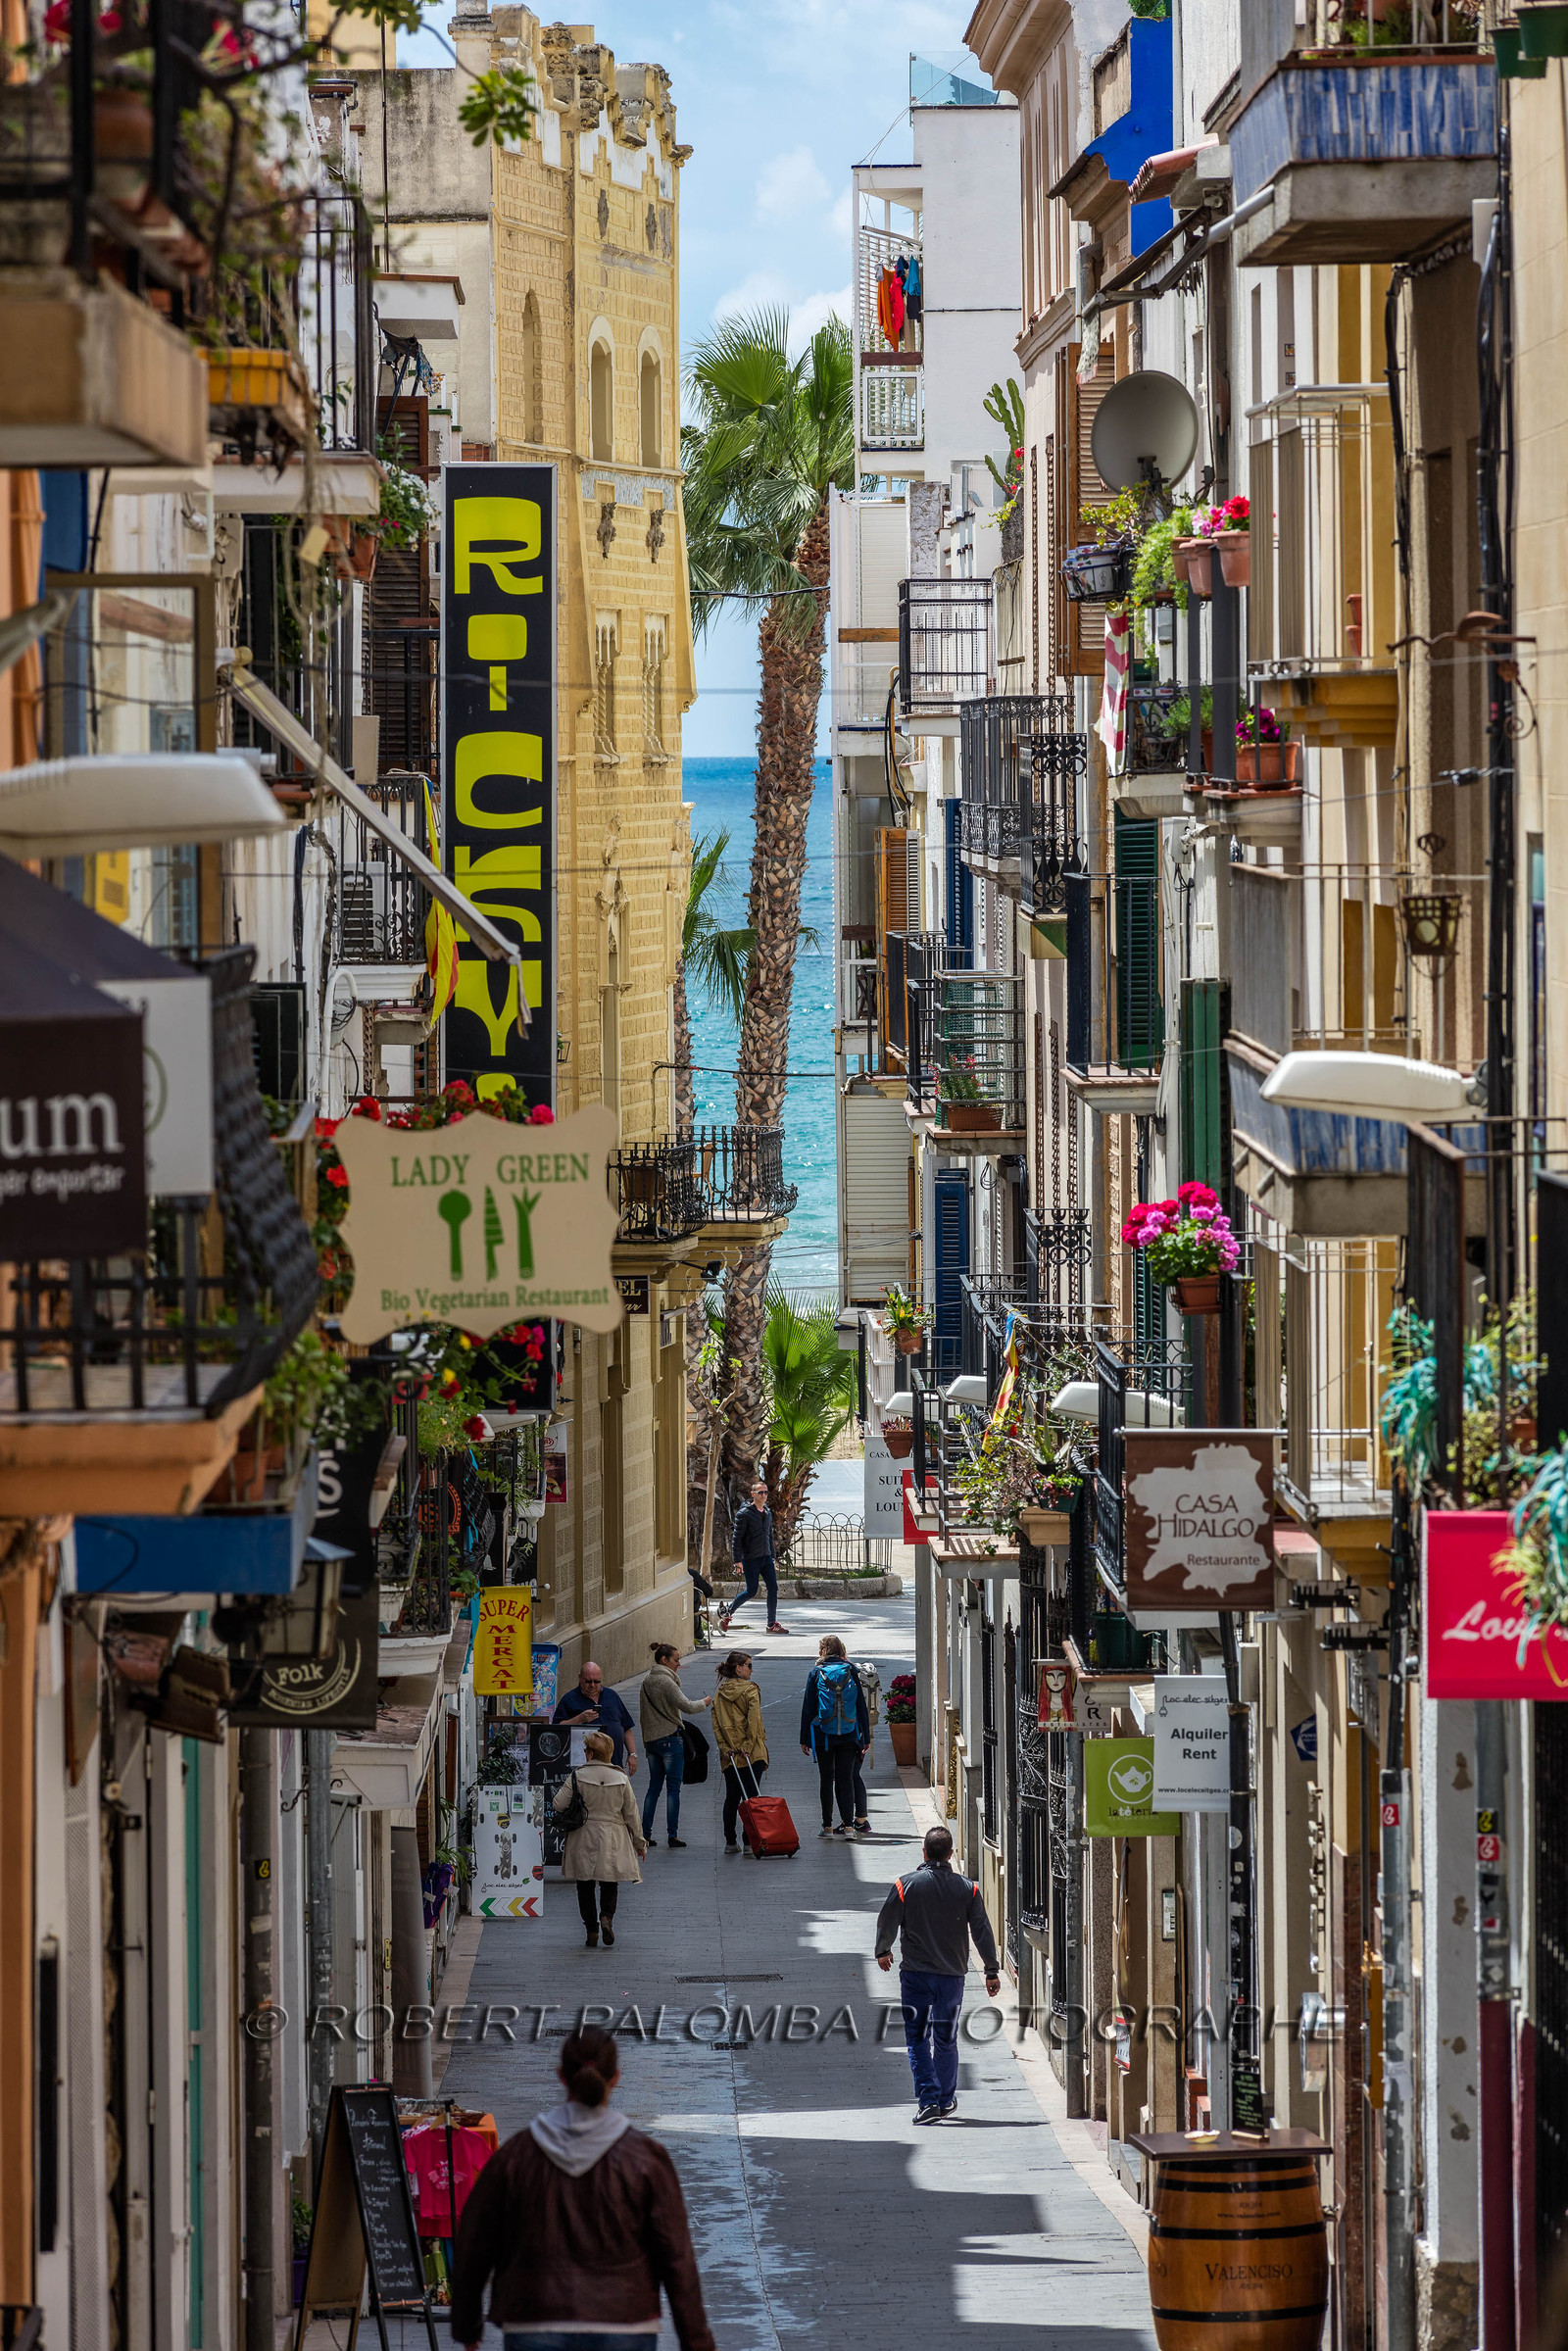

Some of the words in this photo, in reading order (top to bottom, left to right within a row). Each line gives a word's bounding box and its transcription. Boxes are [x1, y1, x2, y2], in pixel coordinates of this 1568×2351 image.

[390, 1153, 470, 1188] LADY
[496, 1151, 590, 1184] GREEN
[380, 1289, 411, 1312] Bio
[415, 1287, 511, 1316] Vegetarian
[514, 1285, 610, 1308] Restaurant
[1176, 1494, 1239, 1514] CASA
[1157, 1513, 1254, 1539] HIDALGO
[1187, 1553, 1260, 1566] Restaurante
[276, 1663, 324, 1687] Folk
[1170, 1728, 1229, 1741] Alquiler
[1182, 1748, 1217, 1760] Rent
[1204, 2263, 1294, 2280] VALENCISO
